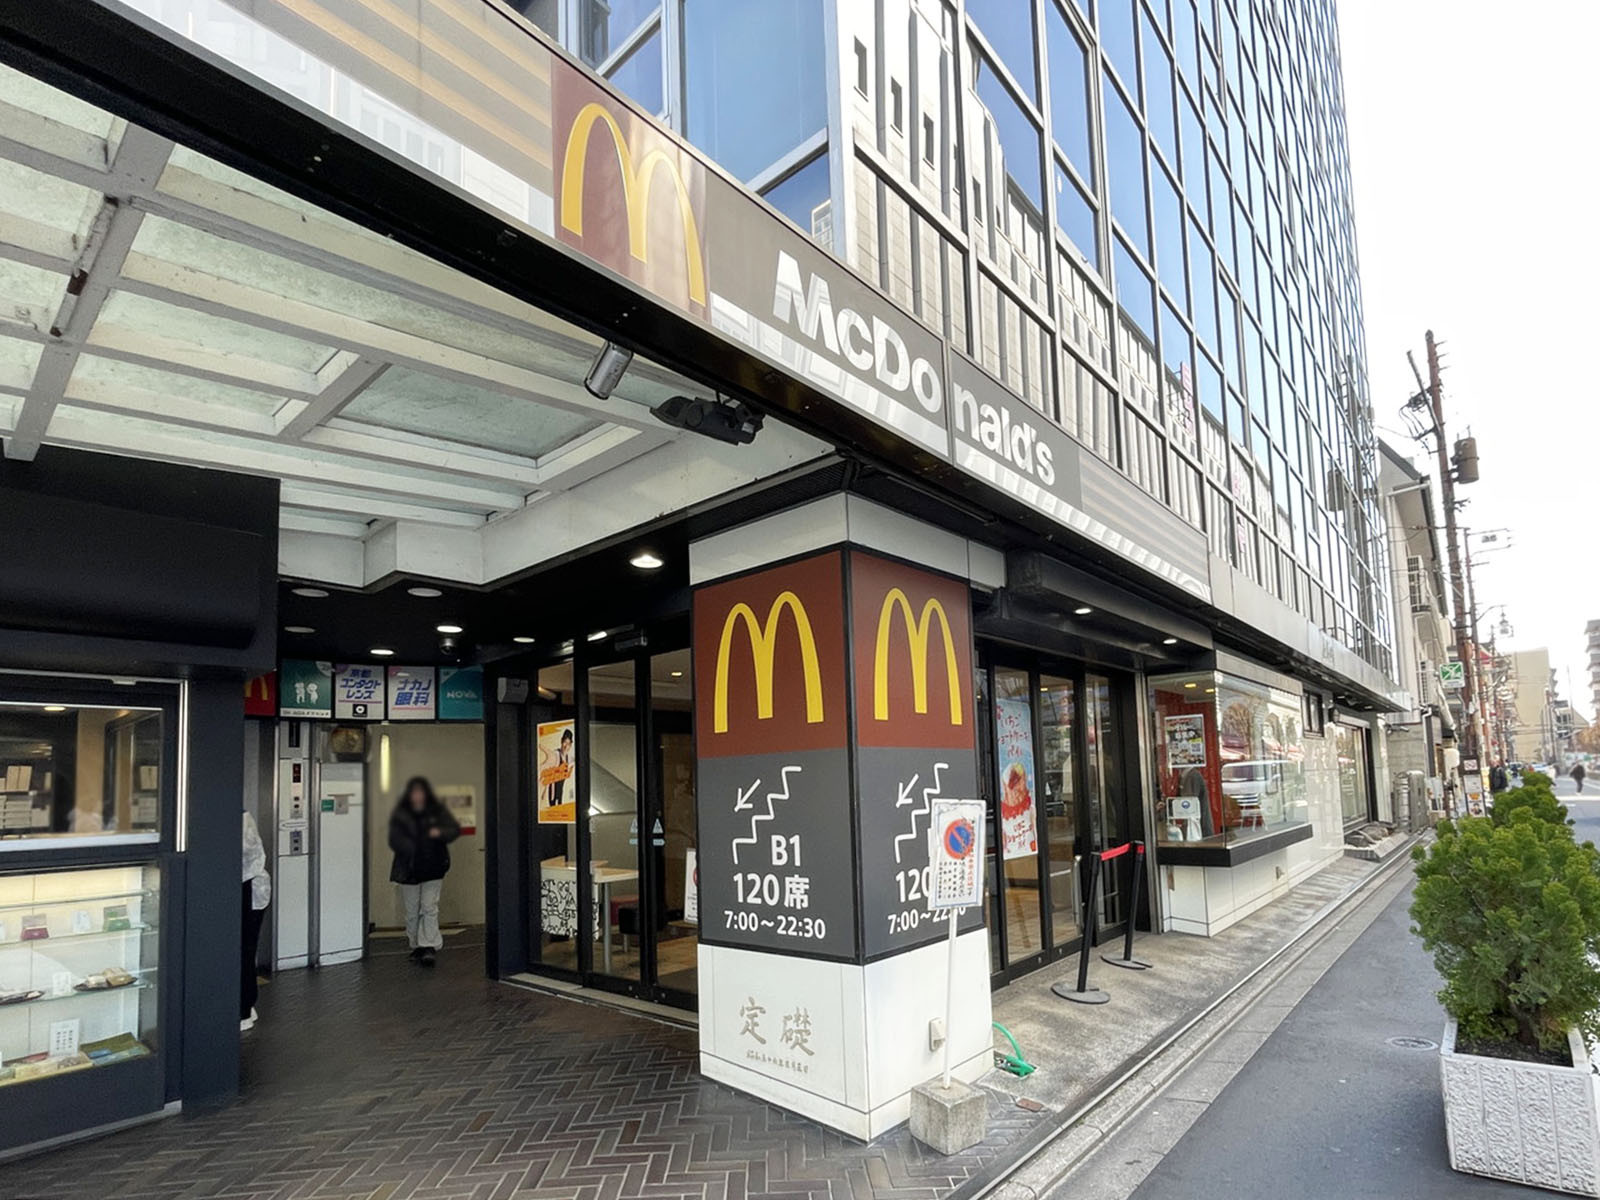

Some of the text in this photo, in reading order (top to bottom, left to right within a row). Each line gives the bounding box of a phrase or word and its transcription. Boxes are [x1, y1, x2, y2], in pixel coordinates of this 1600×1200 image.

[340, 678, 383, 689] コンタクト
[346, 689, 376, 700] レンズ
[394, 691, 431, 706] 眼科
[446, 690, 478, 699] NOVA
[770, 833, 803, 867] B1
[732, 871, 810, 910] 120席
